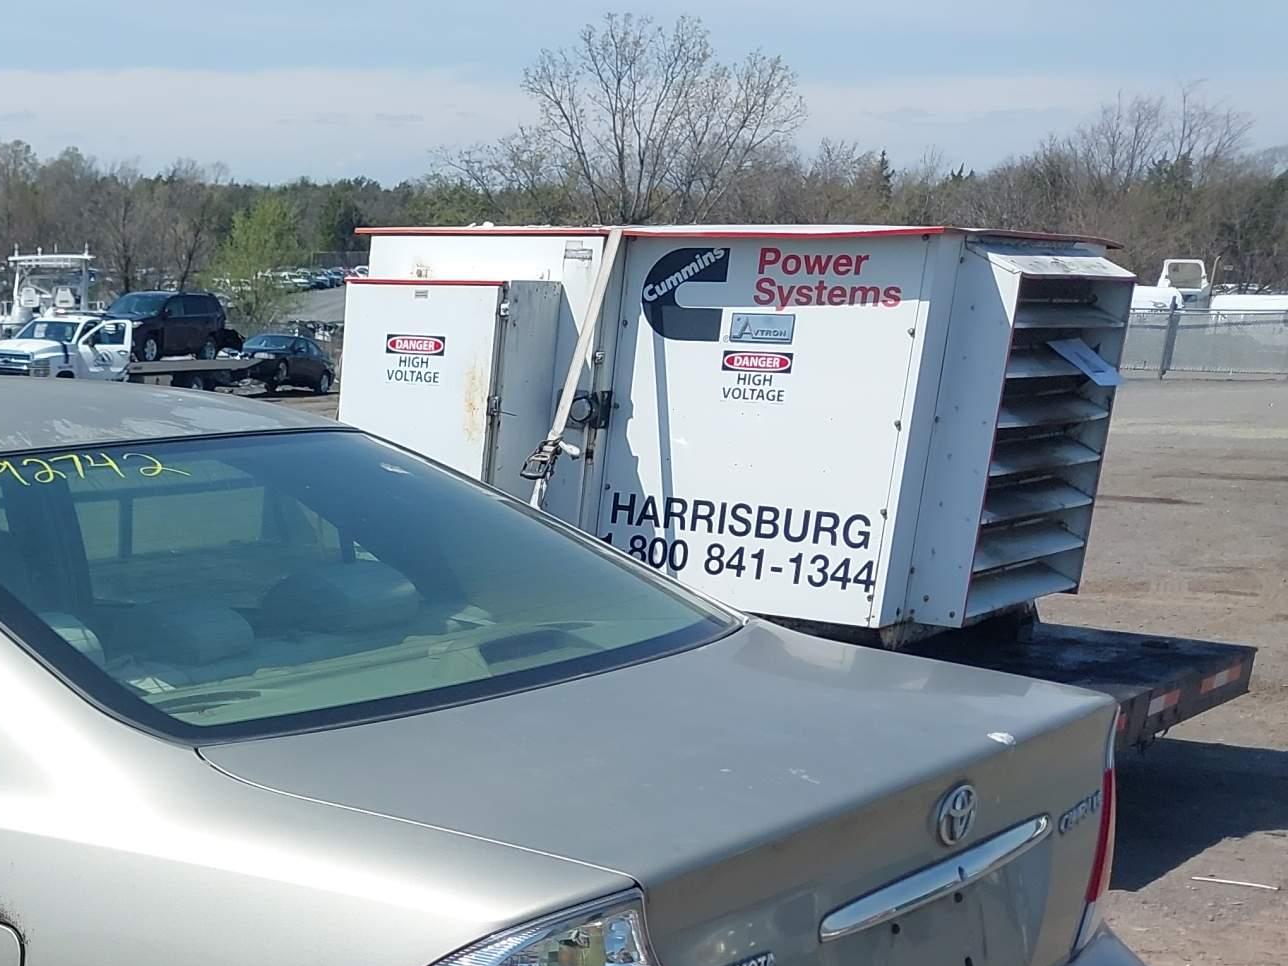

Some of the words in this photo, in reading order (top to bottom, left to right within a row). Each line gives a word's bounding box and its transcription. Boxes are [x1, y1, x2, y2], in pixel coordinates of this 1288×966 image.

[757, 247, 870, 276] Power
[643, 248, 725, 302] Cummins
[753, 277, 901, 311] Systems
[395, 339, 435, 351] DANGER
[398, 355, 430, 369] HIGH
[733, 355, 781, 369] DANGER
[386, 369, 440, 384] VOLTAGE
[736, 373, 773, 387] HIGH
[722, 387, 785, 403] VOLTAGE
[610, 492, 872, 550] HARRISBURG
[703, 543, 876, 593] 841-1344
